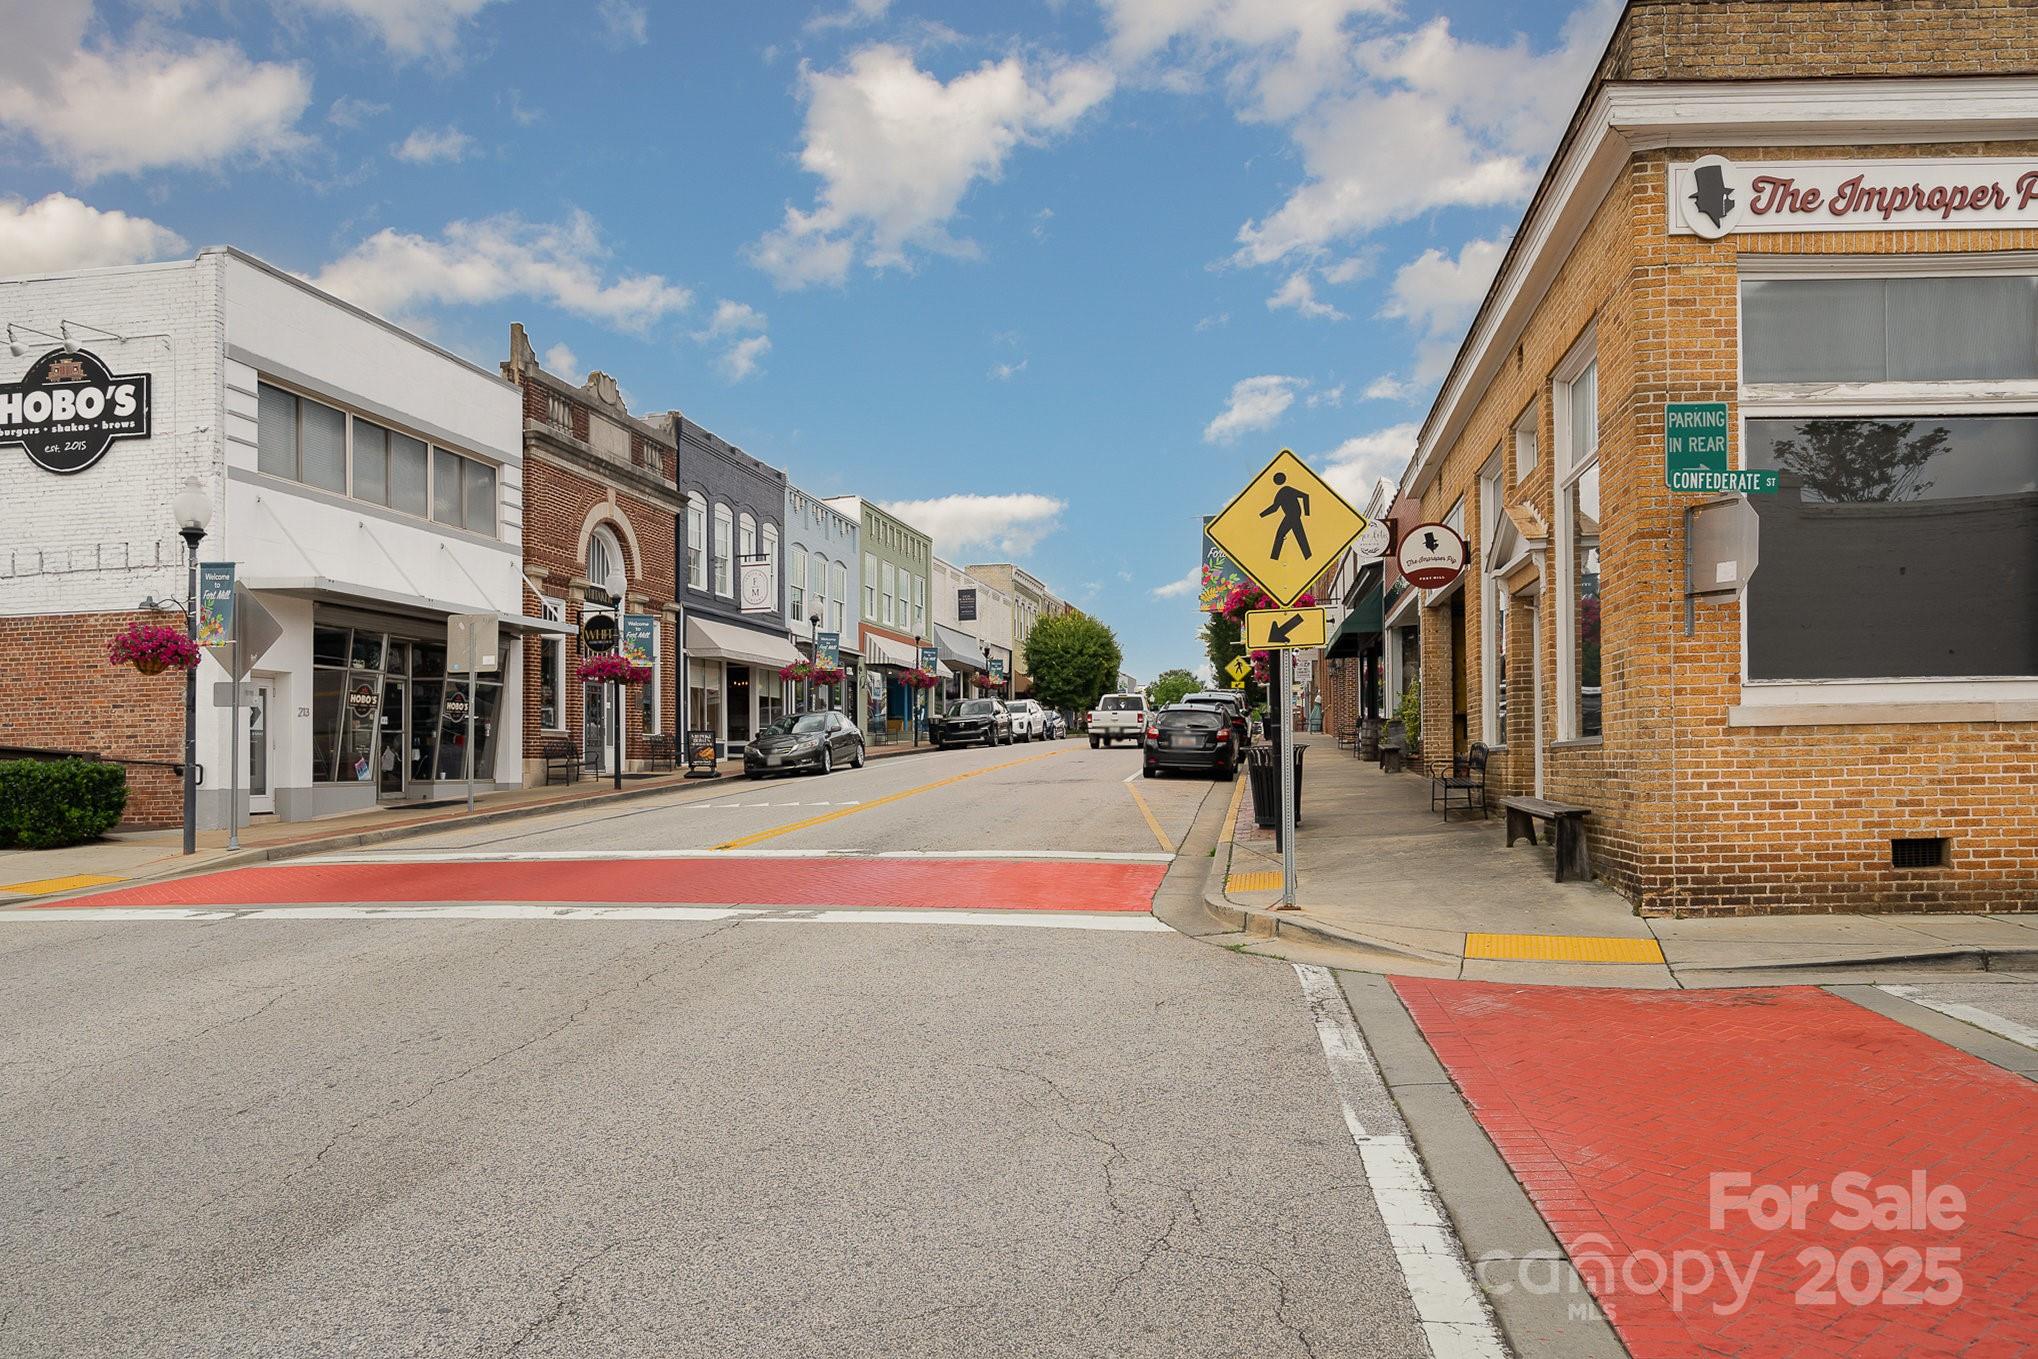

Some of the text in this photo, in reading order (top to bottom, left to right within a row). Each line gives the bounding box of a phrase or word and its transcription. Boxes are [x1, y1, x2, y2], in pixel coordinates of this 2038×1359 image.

[1750, 174, 1824, 215] The
[1828, 173, 2010, 220] Improper
[0, 384, 137, 424] HOBO'S
[1668, 411, 1725, 428] PARKING
[0, 420, 136, 437] burgers shakes brews
[44, 441, 87, 453] est. 2015
[1669, 436, 1725, 453] IN REAR
[1673, 472, 1776, 490] CONFEDERATE ST
[205, 572, 230, 580] Welcome
[203, 589, 231, 600] Fort Mill
[350, 694, 377, 705] HOBO'S
[446, 702, 469, 711] HOBO'S
[297, 706, 310, 718] 213
